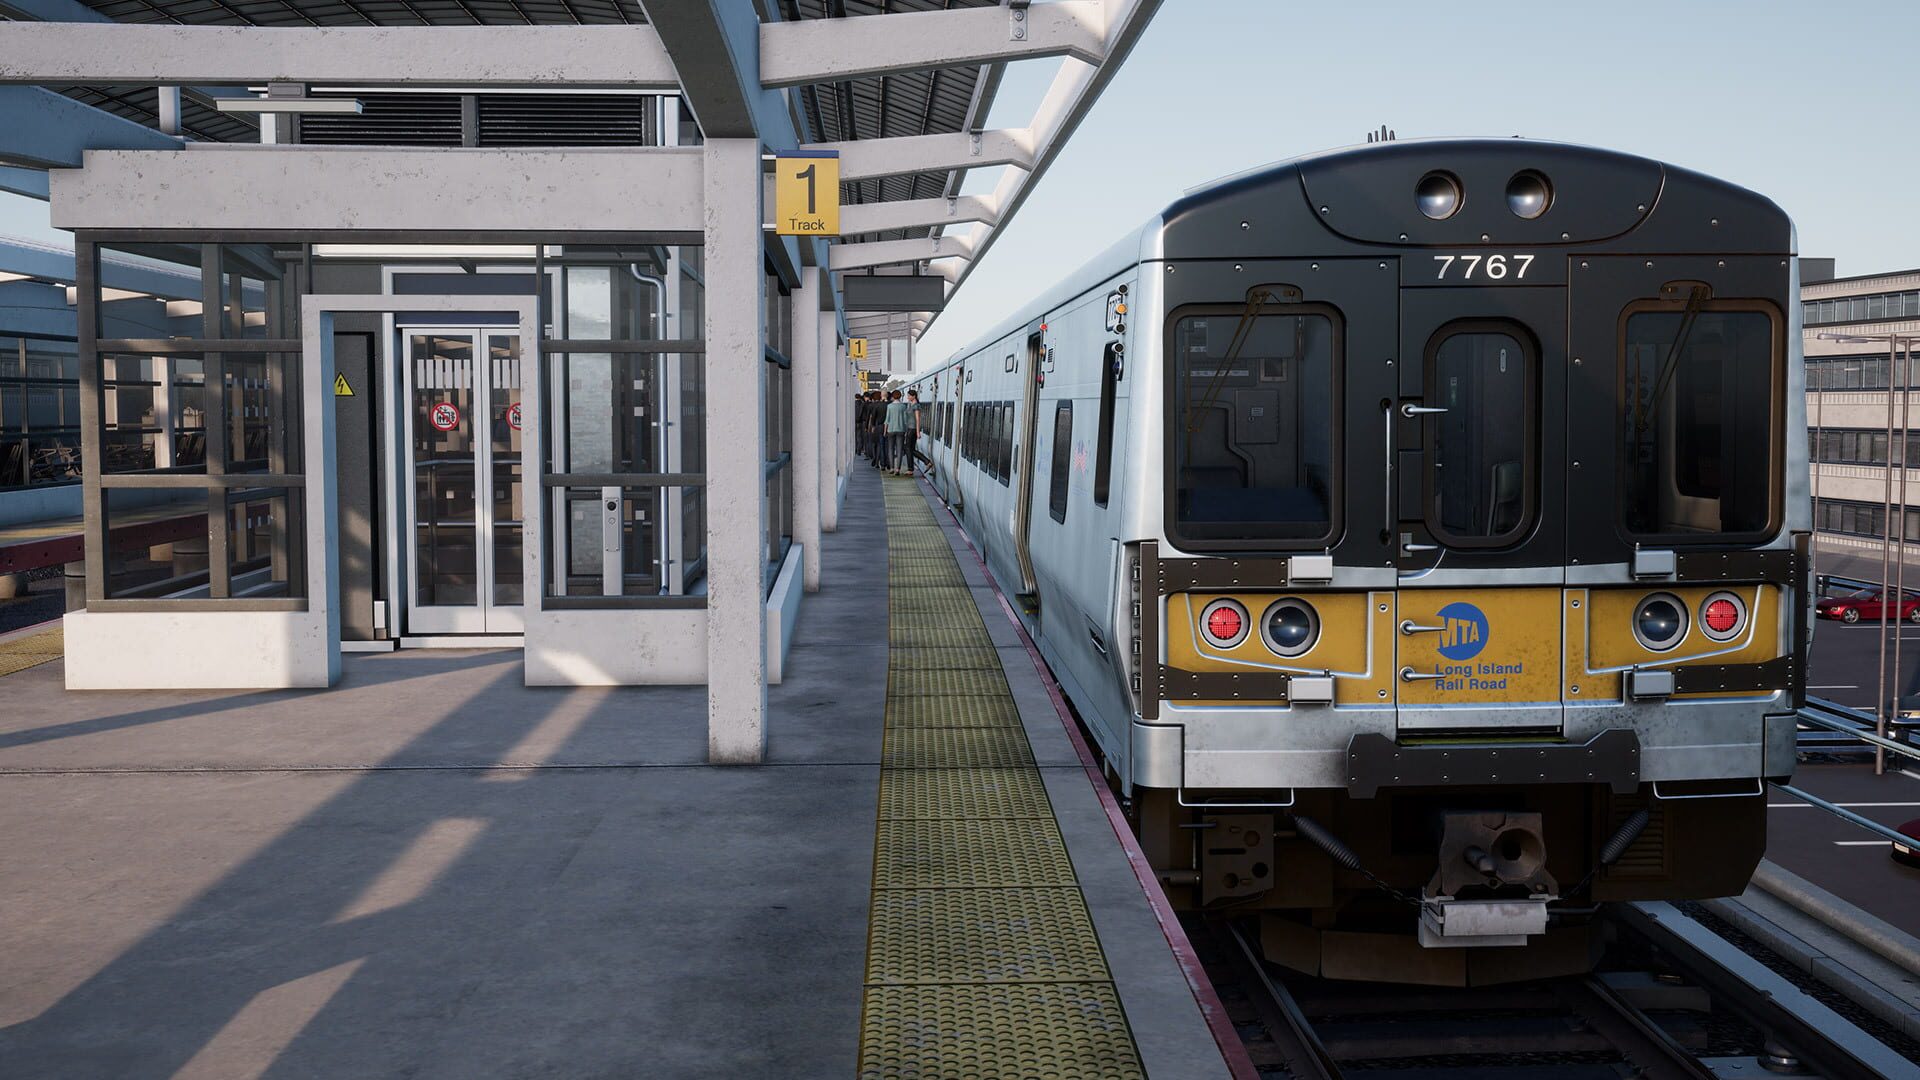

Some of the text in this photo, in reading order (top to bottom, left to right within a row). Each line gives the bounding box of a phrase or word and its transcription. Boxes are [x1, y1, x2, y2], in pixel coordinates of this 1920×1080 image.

[796, 164, 815, 214] 1
[789, 218, 825, 231] Track
[1434, 254, 1535, 279] 7767
[855, 340, 861, 354] 1
[1435, 615, 1479, 648] MTA
[1435, 663, 1523, 677] Long Island
[1435, 678, 1507, 690] Rail Road
